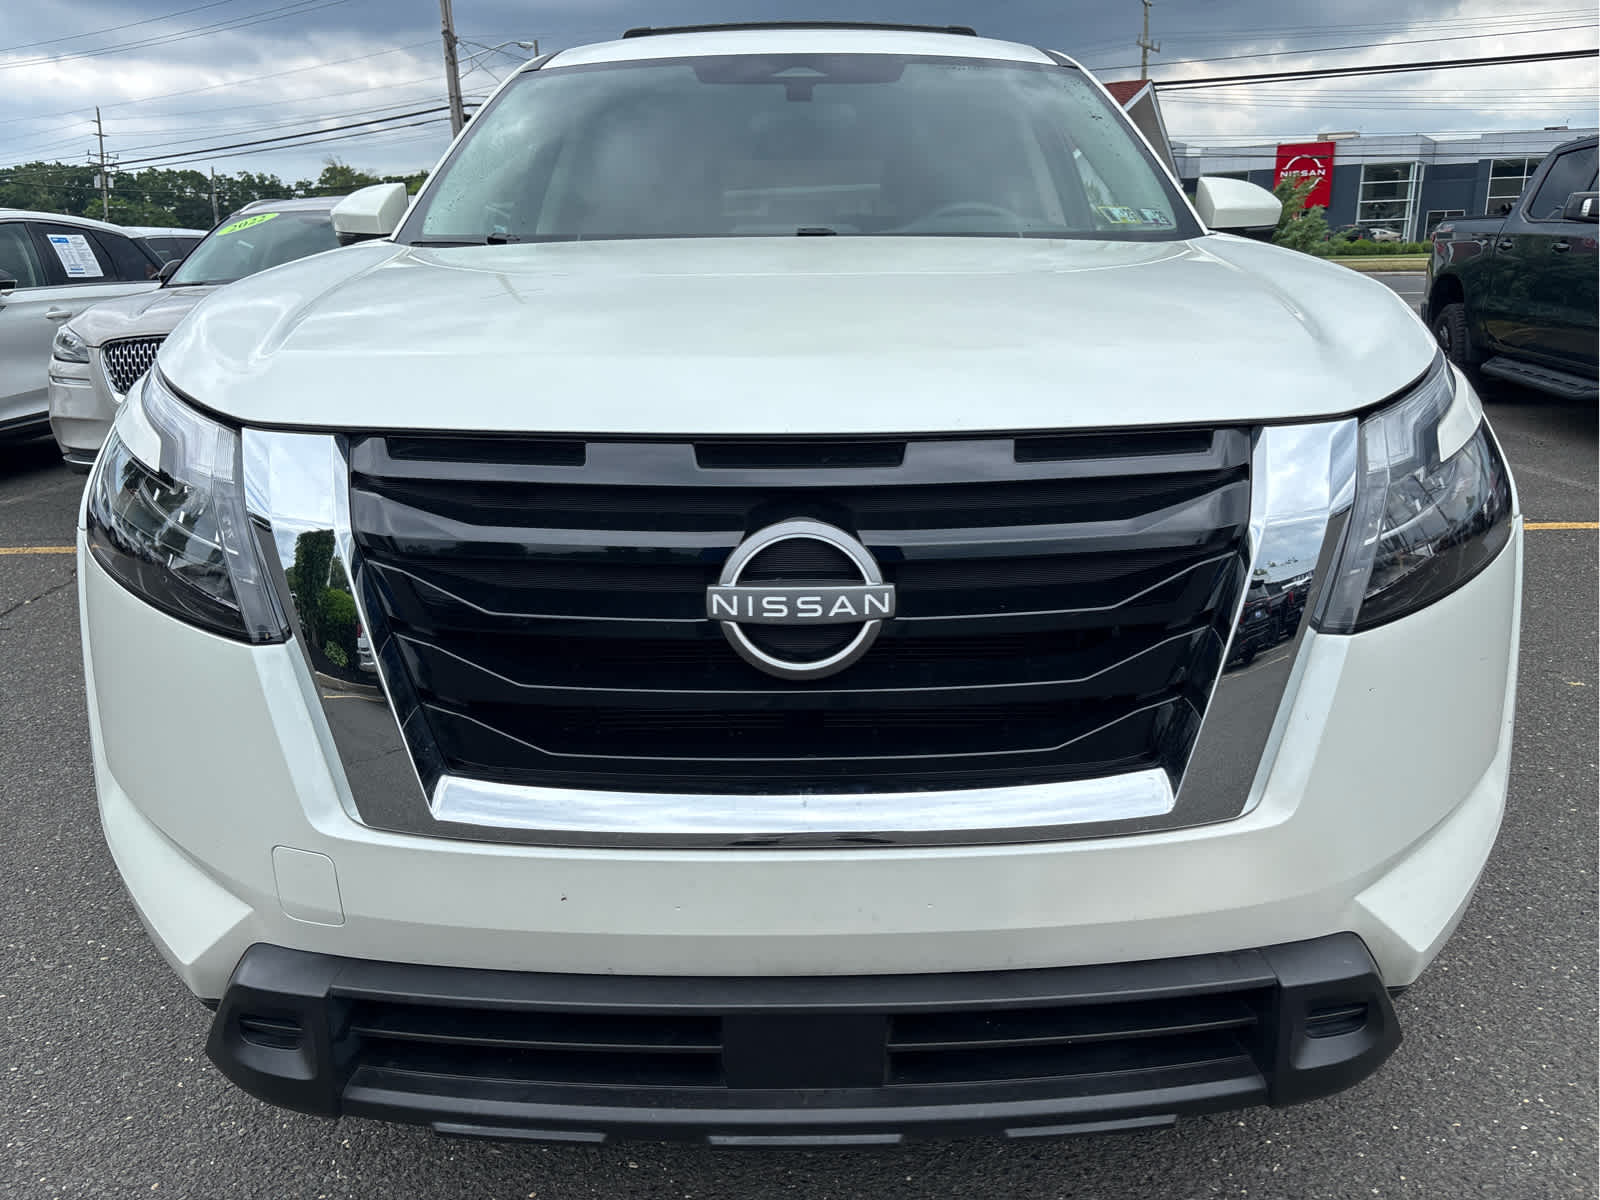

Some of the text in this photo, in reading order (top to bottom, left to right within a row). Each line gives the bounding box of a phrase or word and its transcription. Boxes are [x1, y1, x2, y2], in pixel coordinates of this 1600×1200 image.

[1280, 169, 1326, 178] NISSAN
[228, 215, 266, 232] 2022
[712, 592, 889, 617] NISSAN
